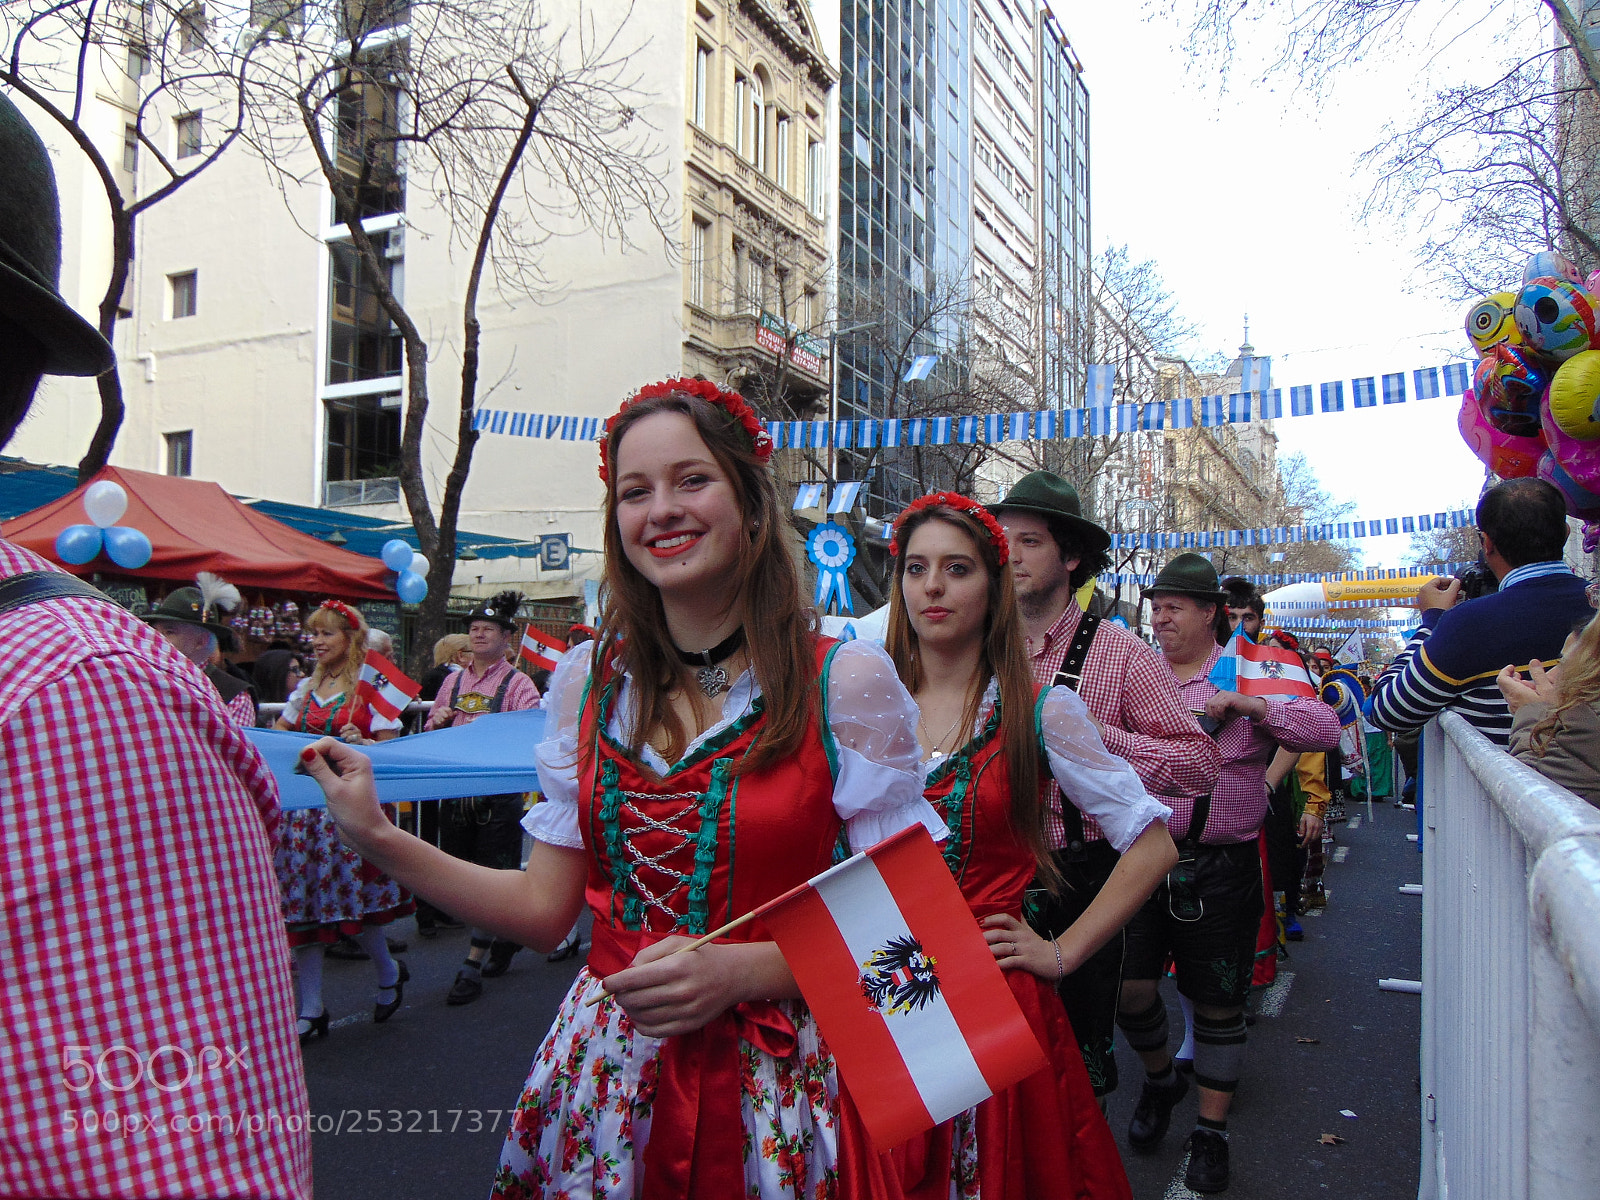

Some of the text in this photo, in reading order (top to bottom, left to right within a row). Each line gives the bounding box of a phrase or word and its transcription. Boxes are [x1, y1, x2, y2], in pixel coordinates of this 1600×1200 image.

[794, 347, 820, 365] ALQUILA
[1345, 586, 1376, 594] Buenos
[1377, 586, 1399, 594] Aires
